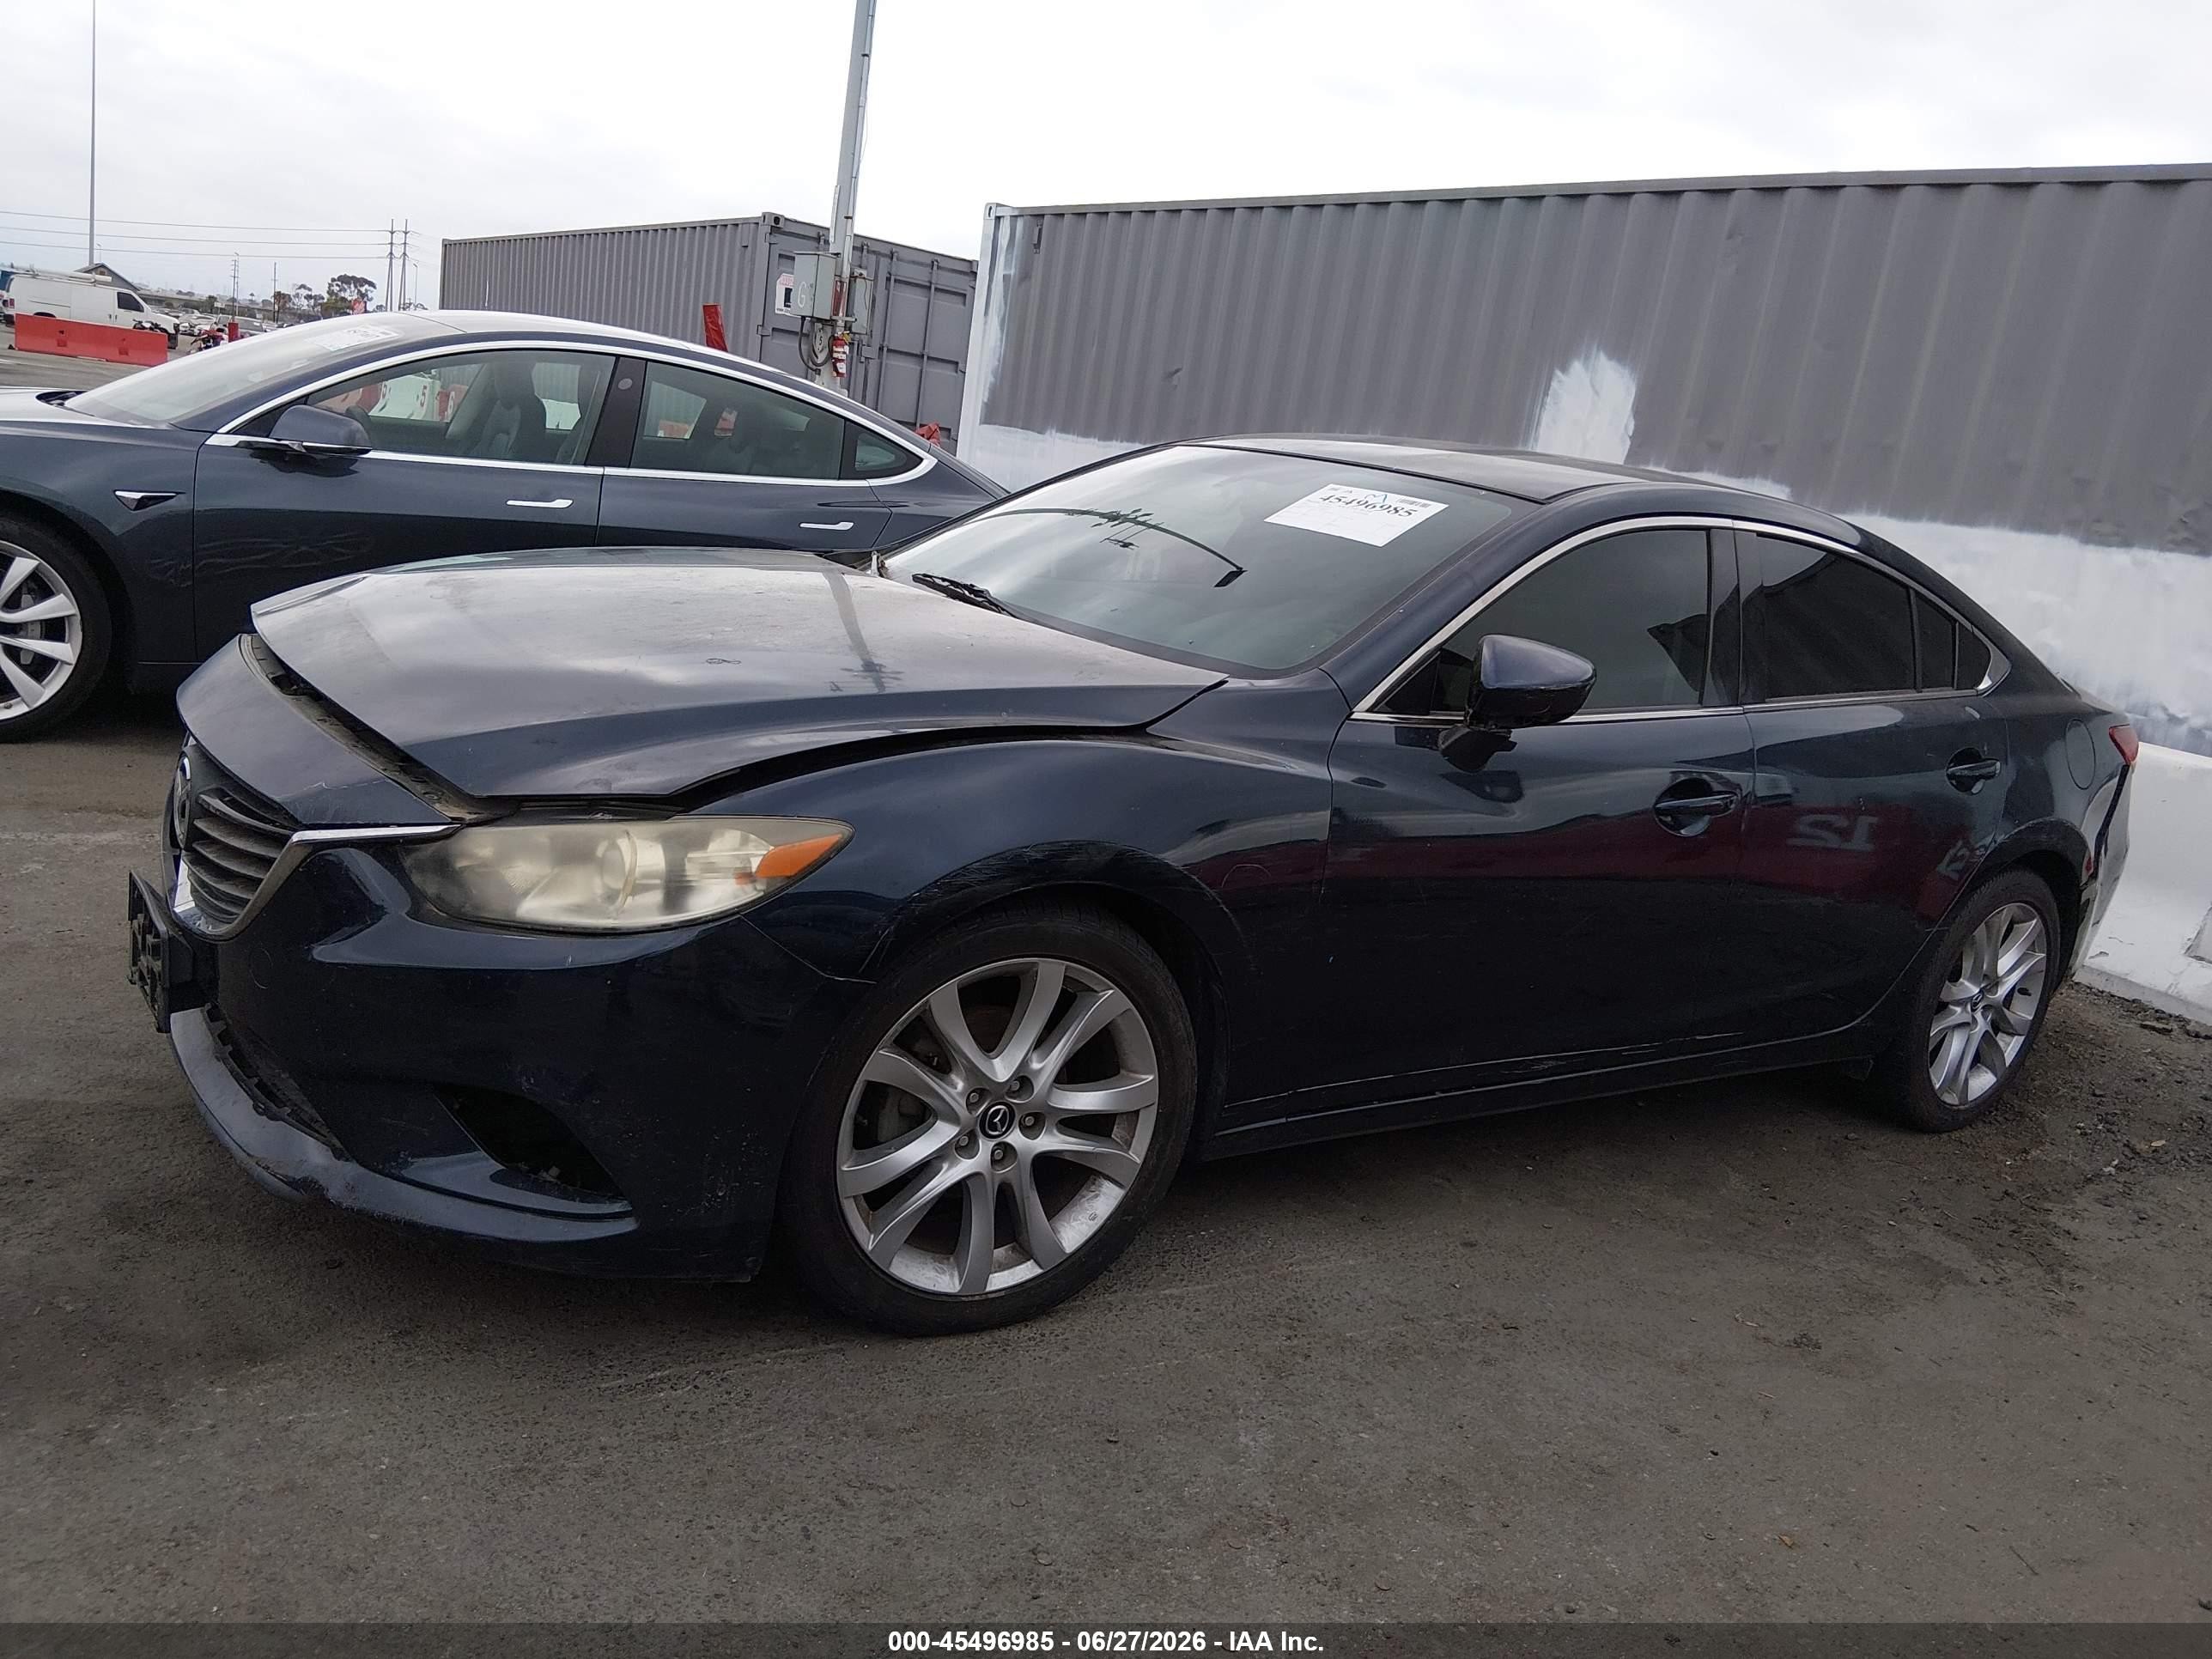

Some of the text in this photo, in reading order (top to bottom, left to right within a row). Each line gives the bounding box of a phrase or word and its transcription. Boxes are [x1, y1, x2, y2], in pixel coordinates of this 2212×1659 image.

[798, 281, 807, 307] G
[420, 386, 428, 407] 5
[1319, 495, 1417, 517] 45496985
